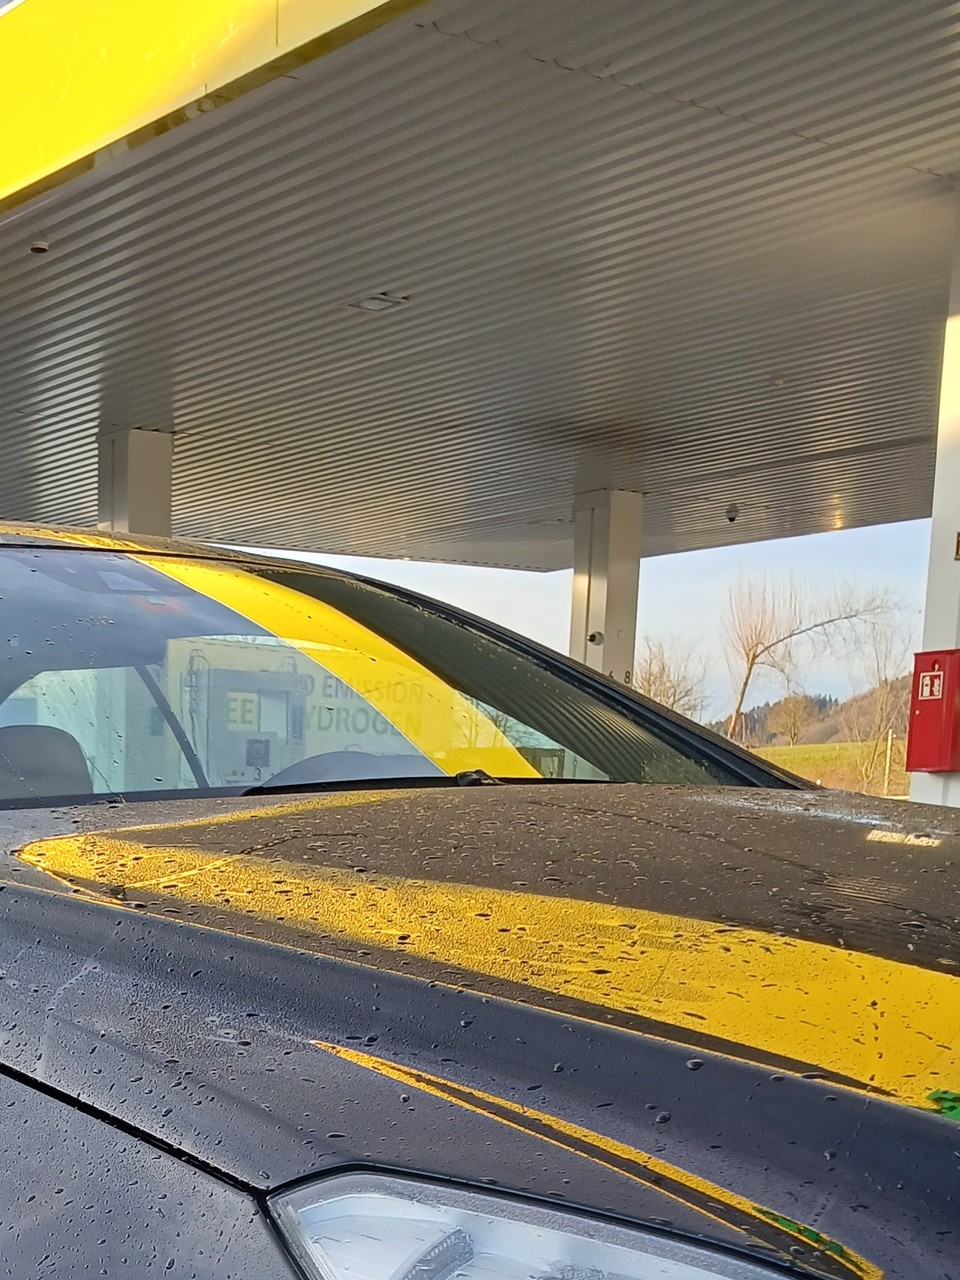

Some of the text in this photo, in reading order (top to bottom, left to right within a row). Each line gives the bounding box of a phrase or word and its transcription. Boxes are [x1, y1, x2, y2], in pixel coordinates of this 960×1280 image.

[322, 675, 424, 705] EMISSION
[624, 670, 631, 684] 8
[305, 705, 422, 738] YDROGEN
